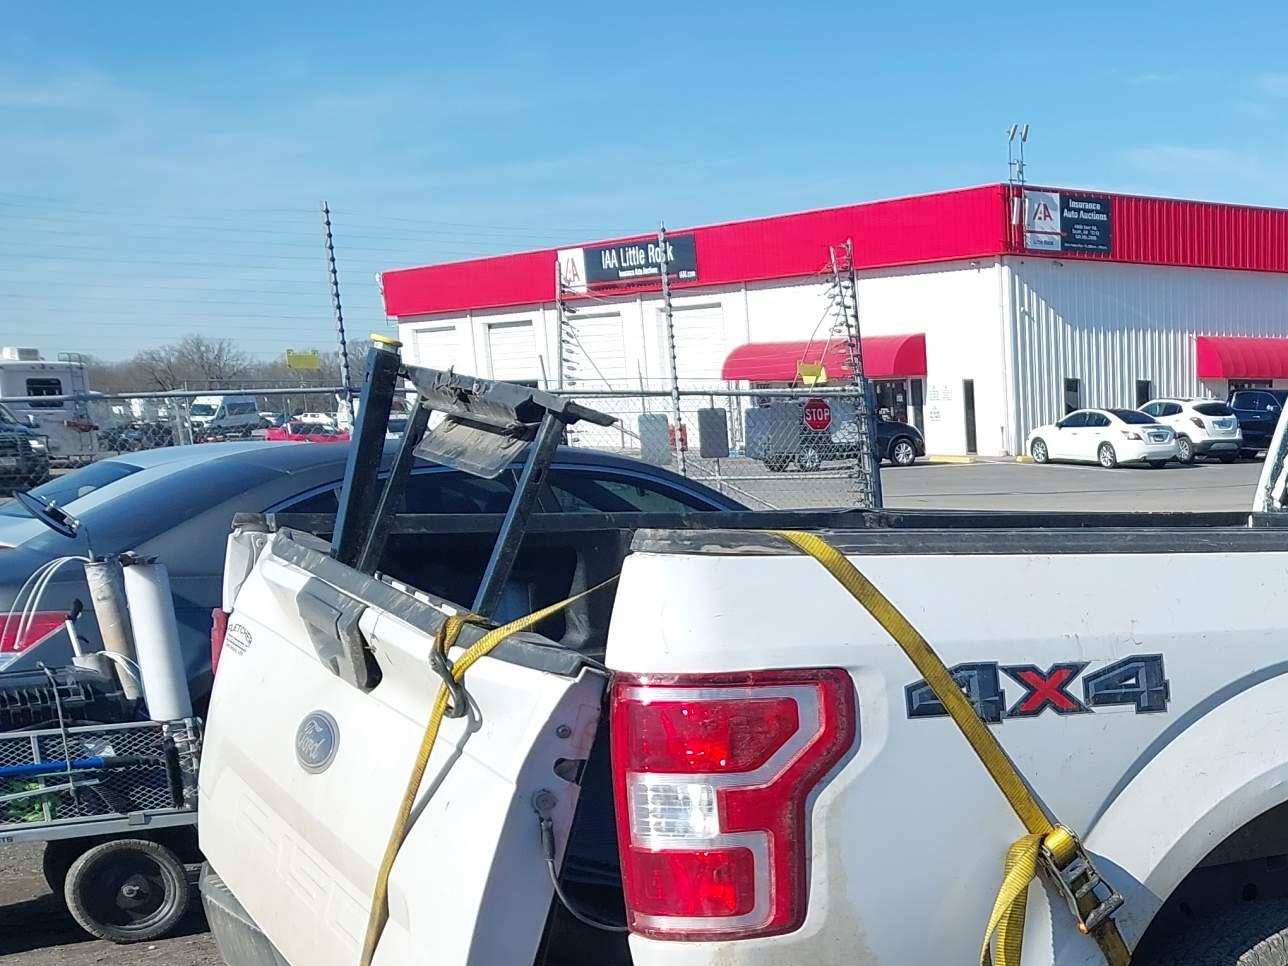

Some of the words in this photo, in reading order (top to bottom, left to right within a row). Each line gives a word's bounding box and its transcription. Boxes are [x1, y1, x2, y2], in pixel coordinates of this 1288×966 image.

[1068, 199, 1101, 210] Insurance
[1063, 208, 1078, 219] Auto
[1079, 209, 1108, 221] Auctions
[601, 248, 619, 269] IAA
[619, 245, 646, 267] Little
[805, 408, 831, 422] STOP
[904, 653, 1170, 724] 4X4
[298, 719, 326, 760] Ford
